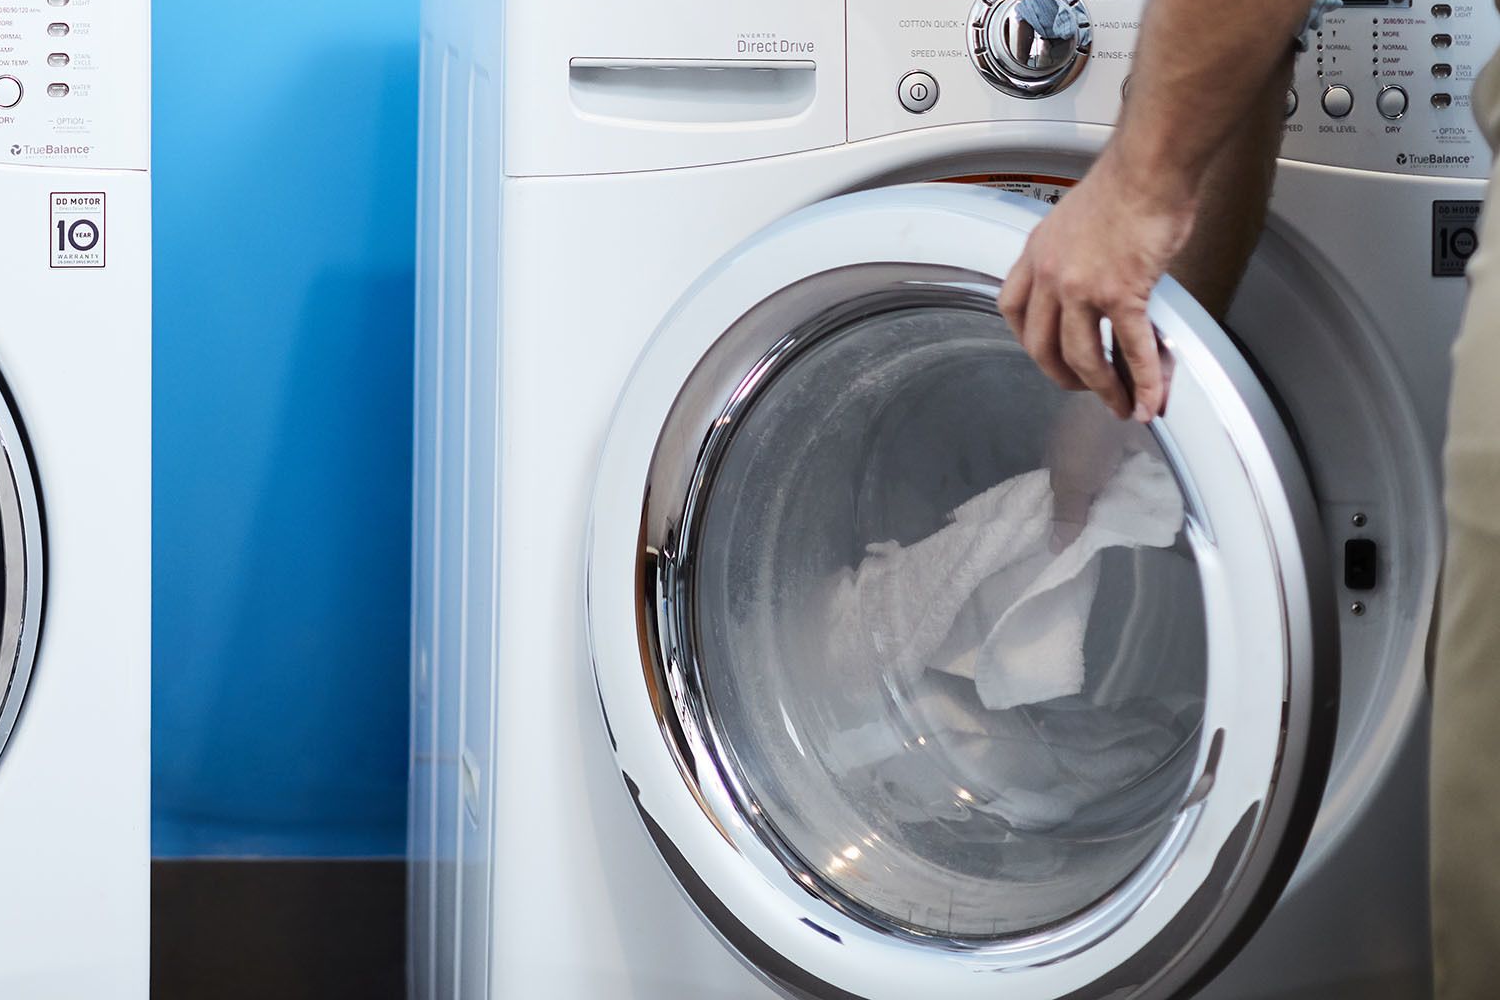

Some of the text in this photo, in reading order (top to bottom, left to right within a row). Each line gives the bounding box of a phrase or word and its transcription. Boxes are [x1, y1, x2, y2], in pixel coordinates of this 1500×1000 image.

[899, 20, 959, 29] COTTON QUICK
[1100, 22, 1120, 30] HAND
[738, 40, 814, 53] Direct Drive
[911, 50, 963, 58] SPEED WASH
[1385, 126, 1402, 134] DRY
[56, 198, 101, 206] DD MOTOR
[57, 219, 100, 251] 10
[1441, 228, 1479, 260] 10
